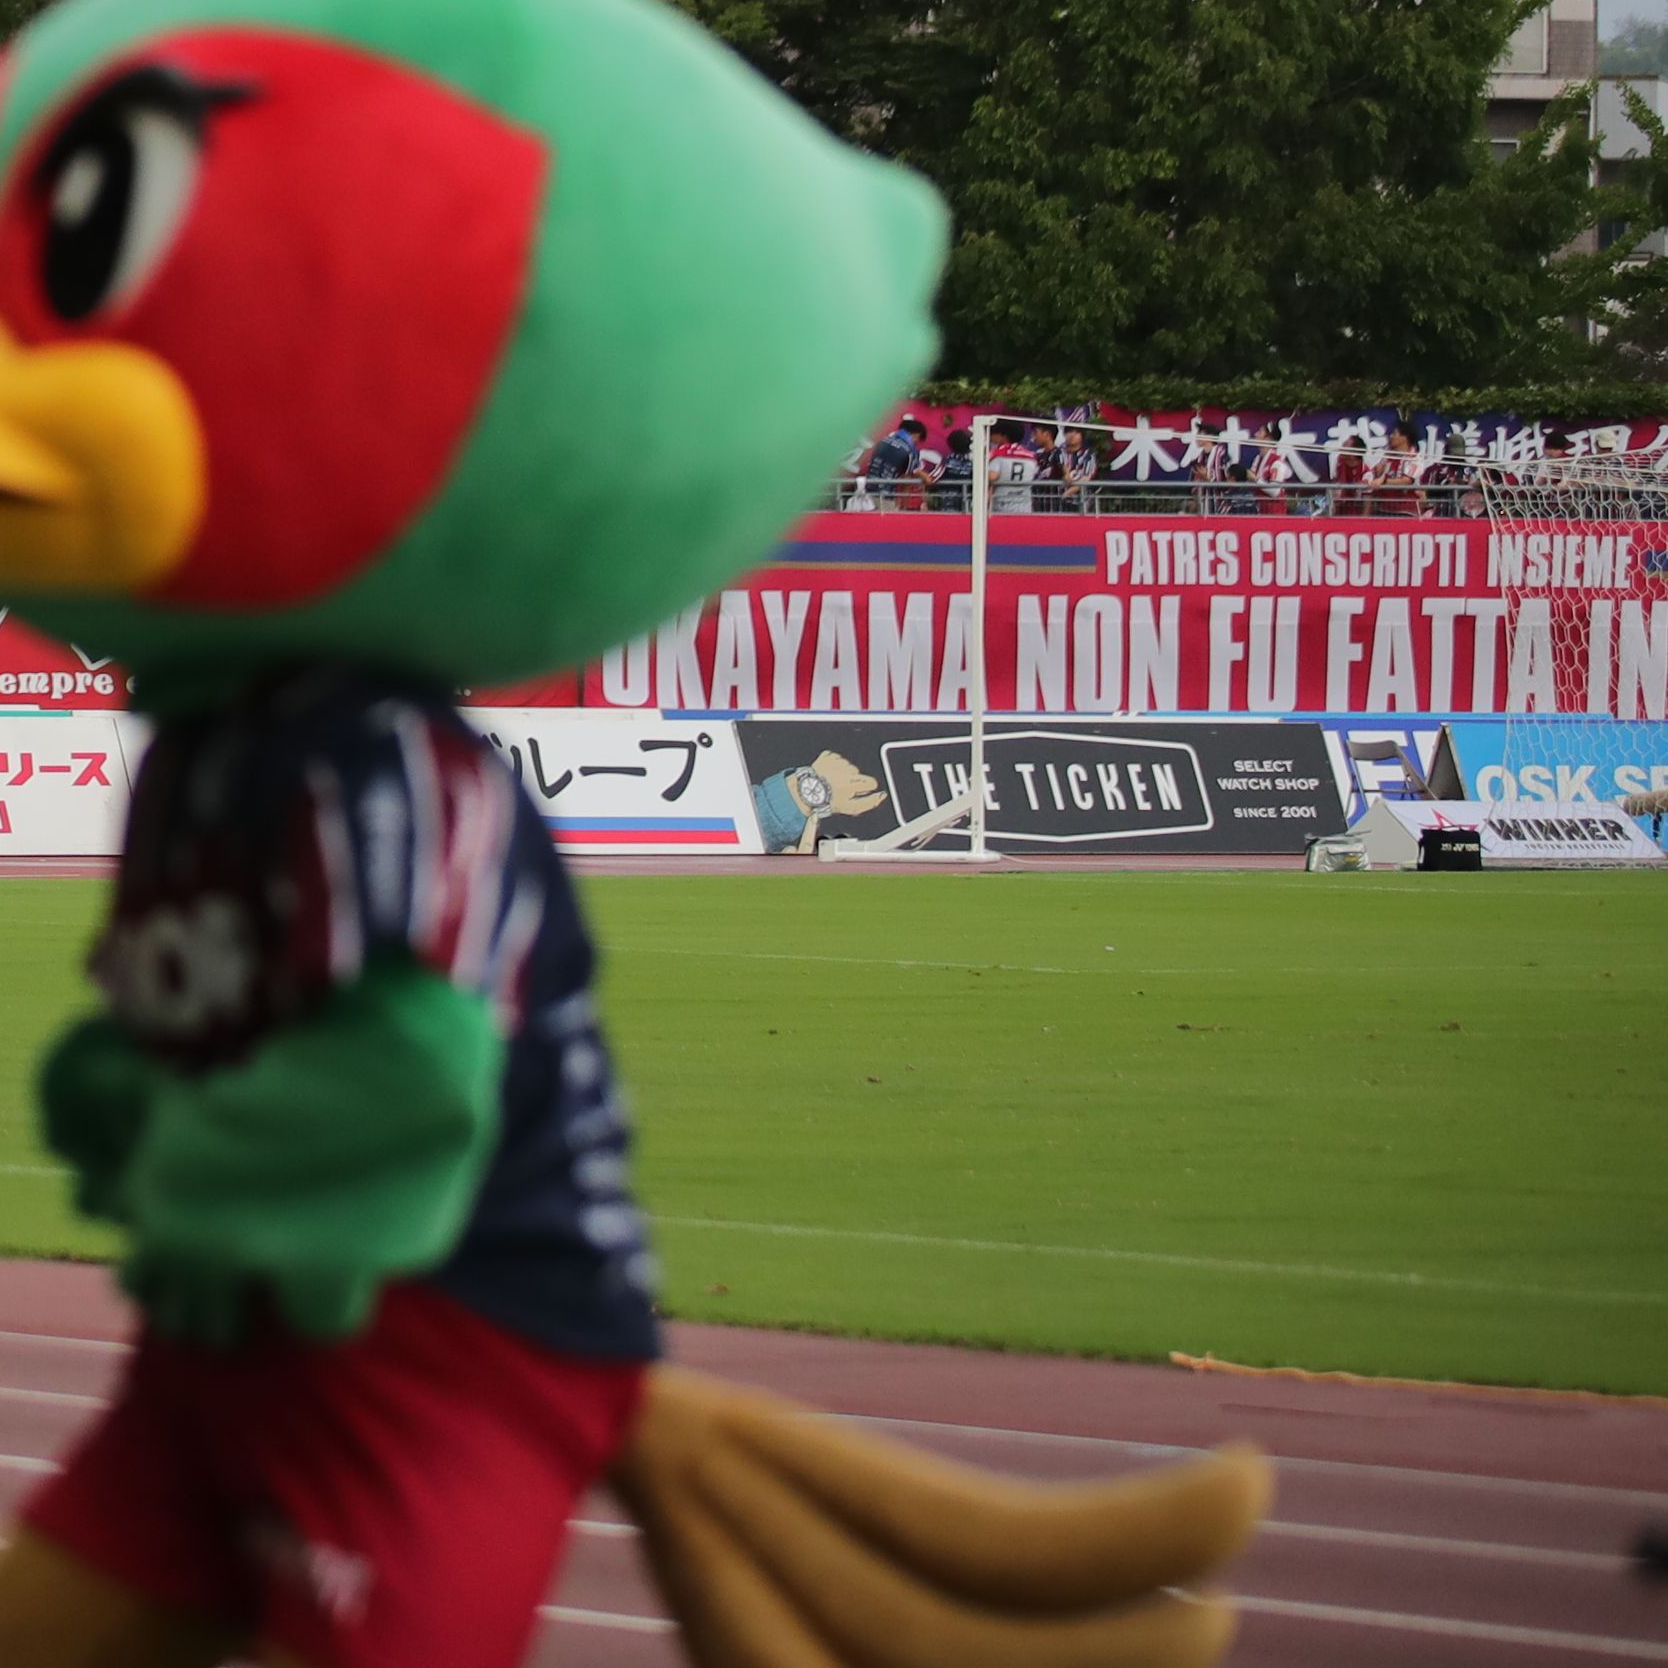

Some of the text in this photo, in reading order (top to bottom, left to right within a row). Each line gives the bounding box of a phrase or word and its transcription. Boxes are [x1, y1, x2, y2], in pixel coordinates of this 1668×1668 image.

[1105, 530, 1633, 589] PATRES CONSCRIPTI INSIEME
[1015, 593, 1181, 713] NON
[1208, 594, 1303, 713] FU
[1325, 595, 1558, 716] FATTA
[1585, 599, 1668, 720] IN
[482, 732, 714, 803] ループ
[1217, 777, 1321, 791] WATCH SHOP
[1233, 759, 1294, 773] SELECT
[1475, 764, 1597, 803] OSK
[1014, 762, 1183, 811] TICKEN
[1233, 806, 1317, 819] SINCE 2001
[1484, 818, 1632, 842] WINNER
